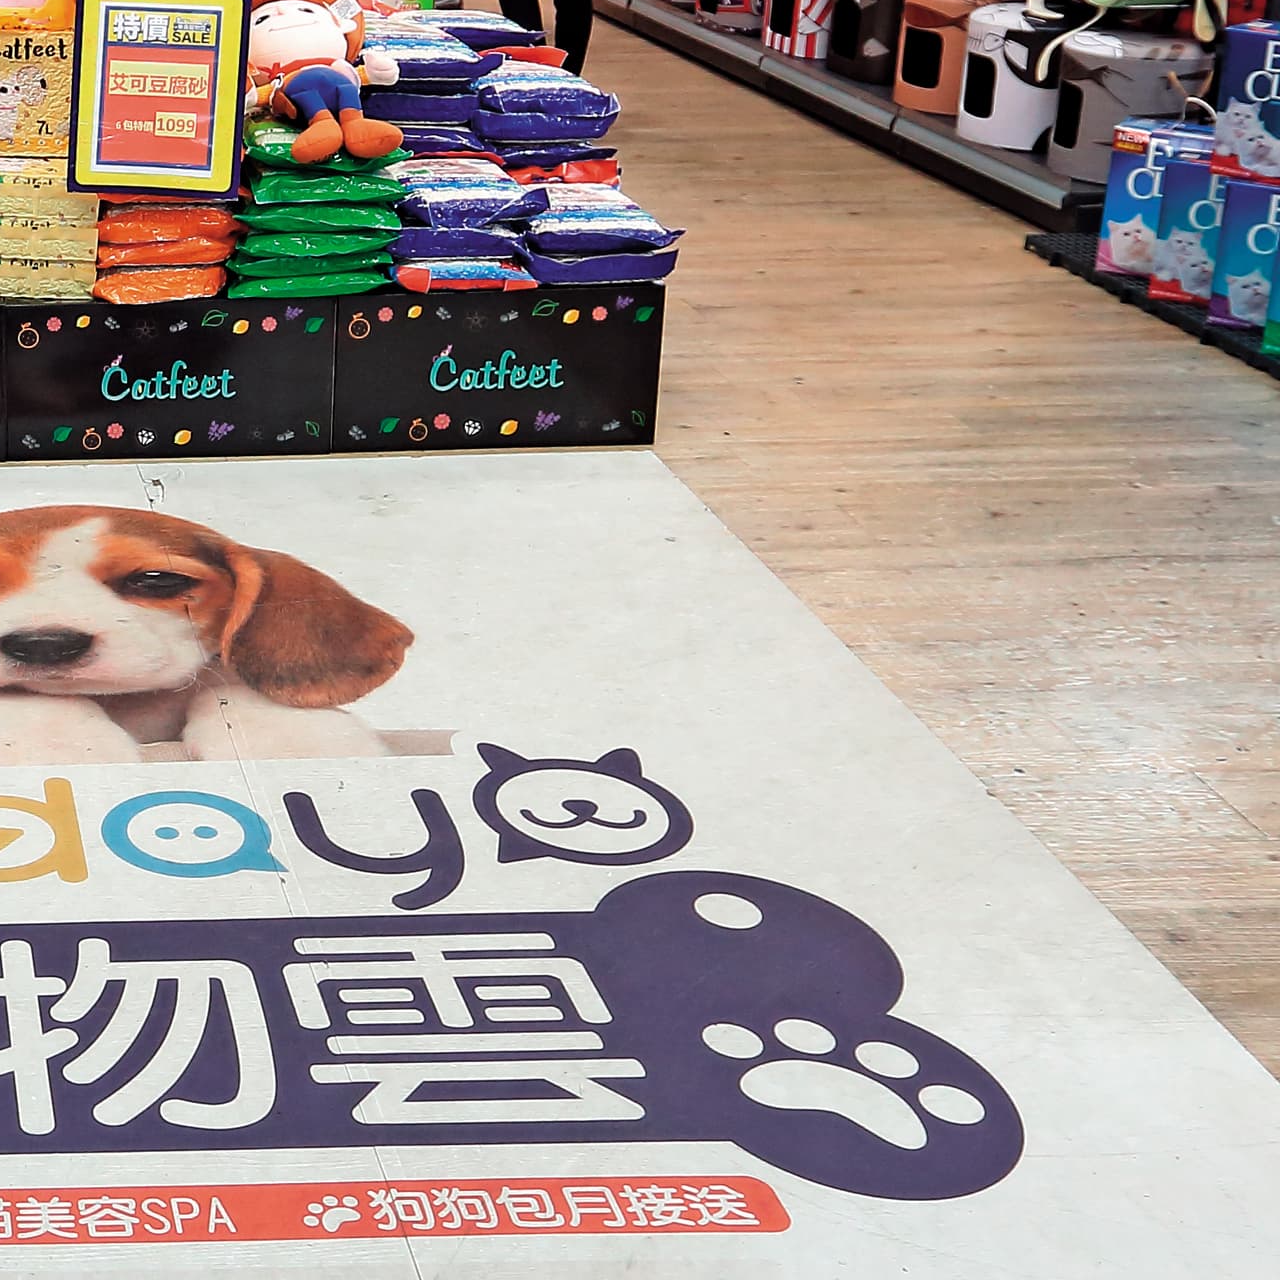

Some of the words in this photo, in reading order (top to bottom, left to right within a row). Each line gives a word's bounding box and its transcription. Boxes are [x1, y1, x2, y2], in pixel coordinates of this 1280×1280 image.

[113, 12, 171, 43] 特價
[171, 31, 211, 45] SALE
[109, 71, 209, 96] 艾可豆腐砂
[36, 120, 54, 136] 7L
[156, 117, 196, 134] 1099
[100, 360, 237, 402] Catfeet
[429, 349, 565, 393] Catfeet
[368, 1185, 759, 1233] 狗狗包月接送
